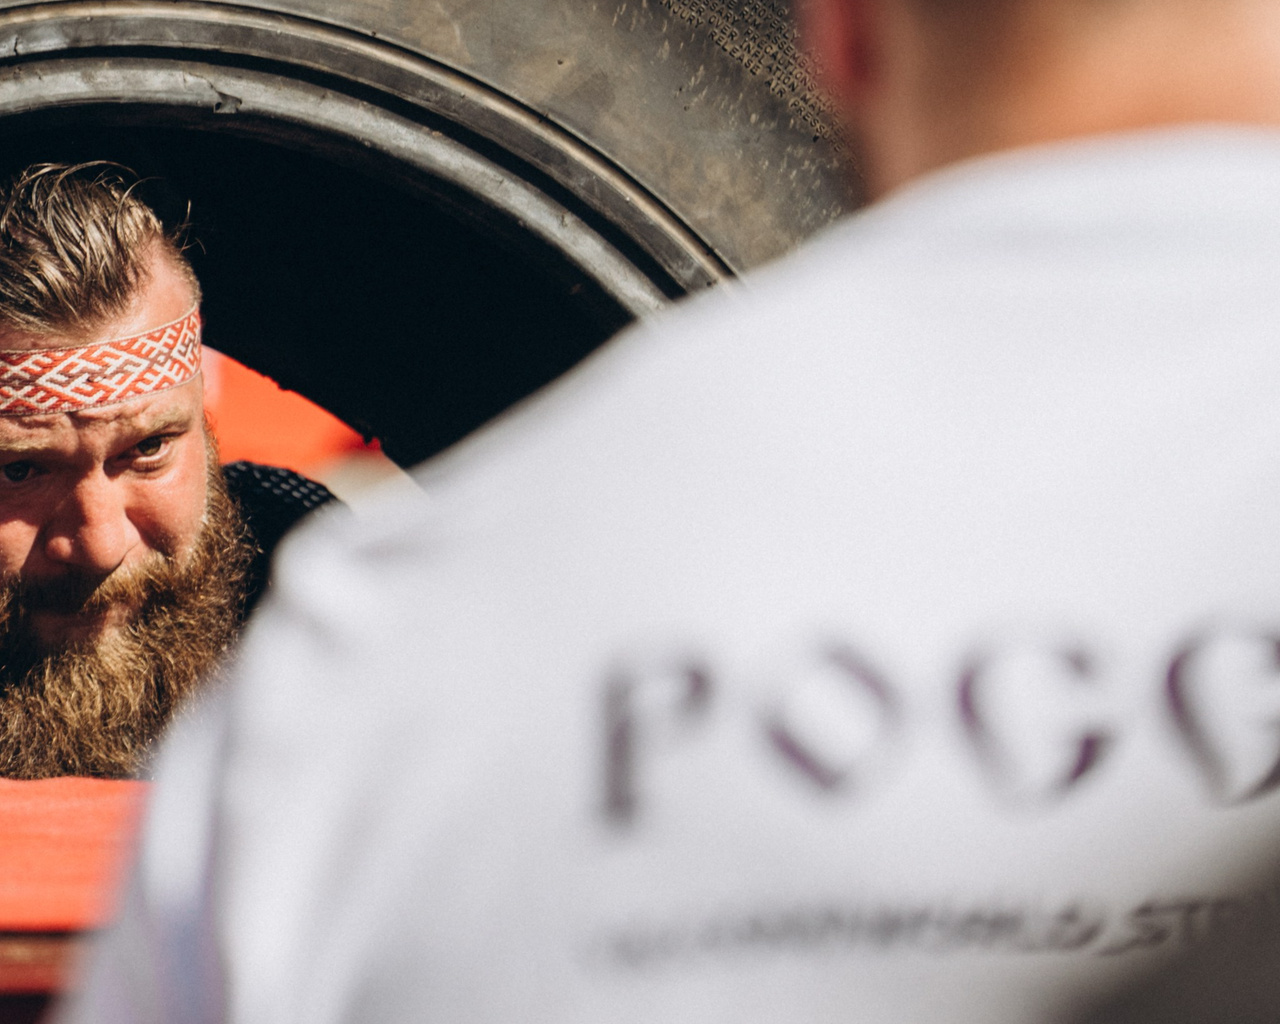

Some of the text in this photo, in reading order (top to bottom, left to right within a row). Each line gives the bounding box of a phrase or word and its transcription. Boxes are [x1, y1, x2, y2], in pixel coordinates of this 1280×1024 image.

[708, 14, 739, 40] OVER
[740, 37, 798, 92] INFLATION
[800, 92, 826, 116] MAY
[709, 26, 762, 76] RELEASE
[764, 75, 786, 97] AIR
[789, 98, 841, 153] PRESSURE
[740, 7, 762, 29] RIM
[766, 30, 824, 79] ASSEMBLY
